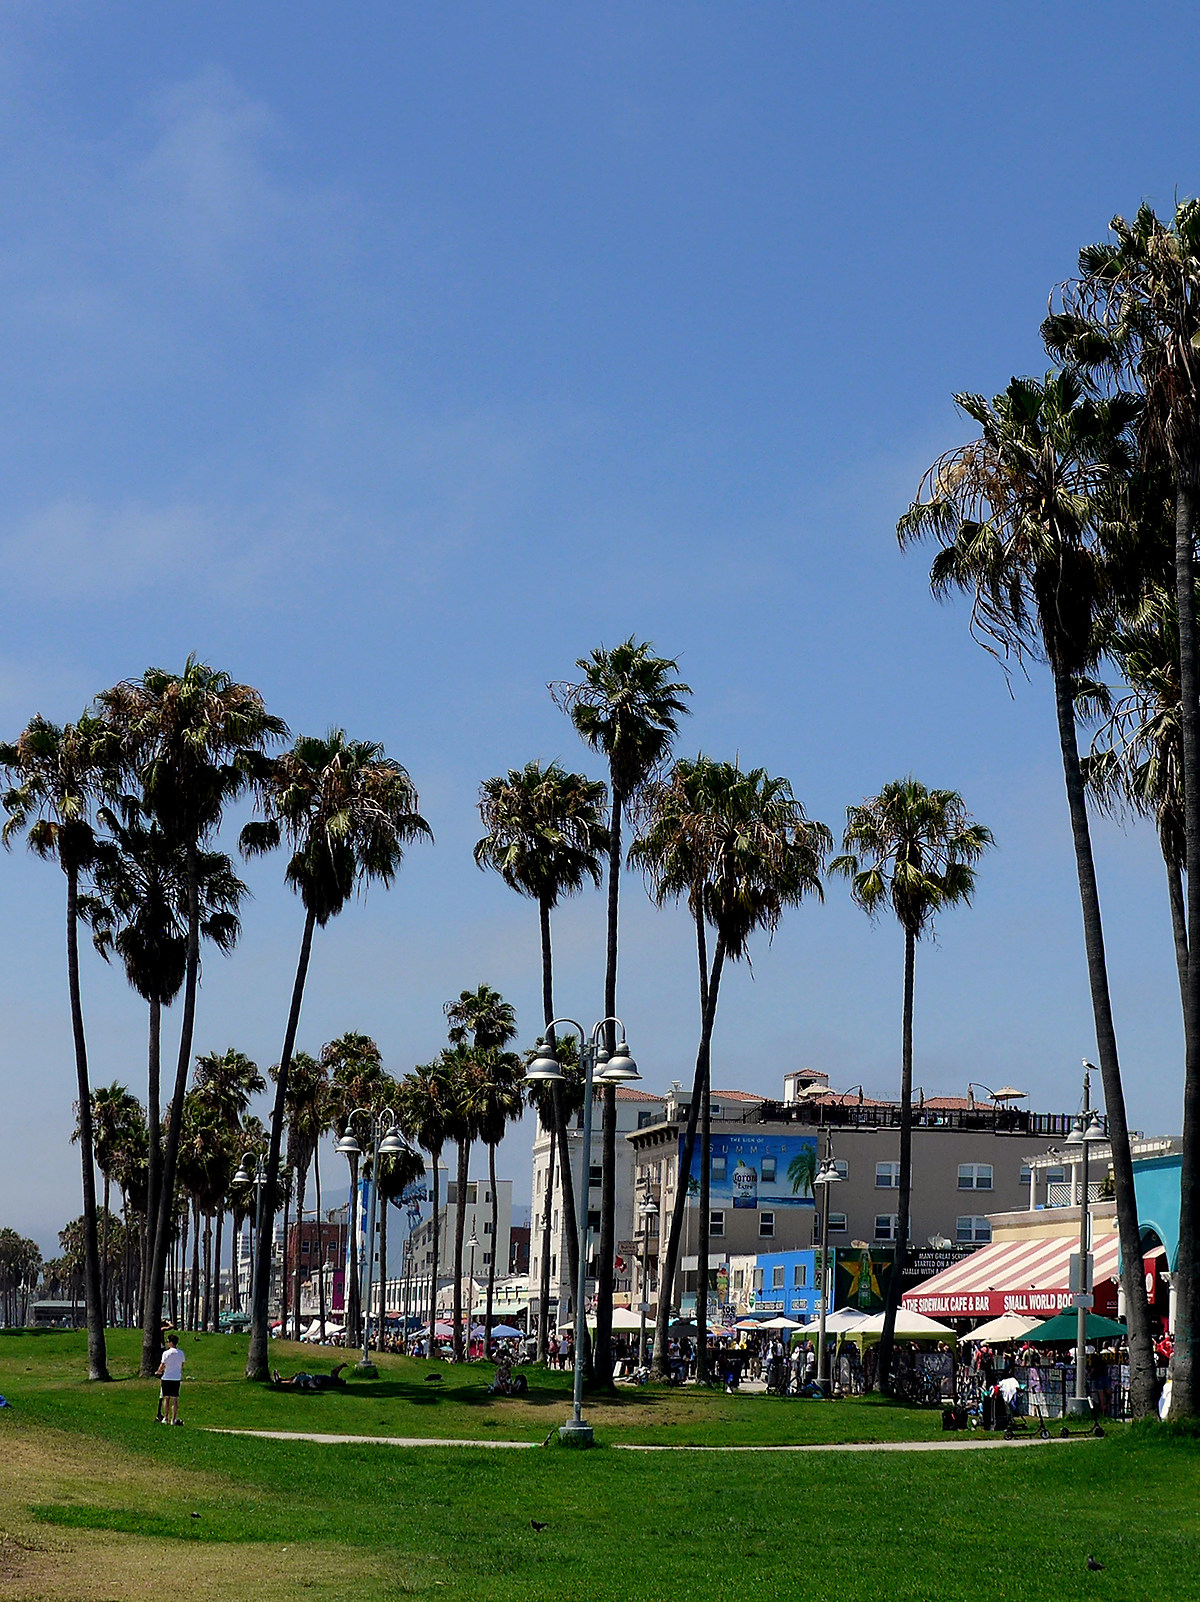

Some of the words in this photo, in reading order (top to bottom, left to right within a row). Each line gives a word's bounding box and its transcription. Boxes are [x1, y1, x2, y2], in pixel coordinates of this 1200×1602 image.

[709, 1143, 787, 1154] SUMMER
[906, 1298, 918, 1312] THE
[918, 1297, 950, 1312] SIDEWALK
[950, 1296, 967, 1311] CAFE
[968, 1296, 974, 1311] &
[975, 1296, 990, 1311] BAR
[1003, 1295, 1028, 1311] SMALL
[1029, 1294, 1056, 1310] WORLD
